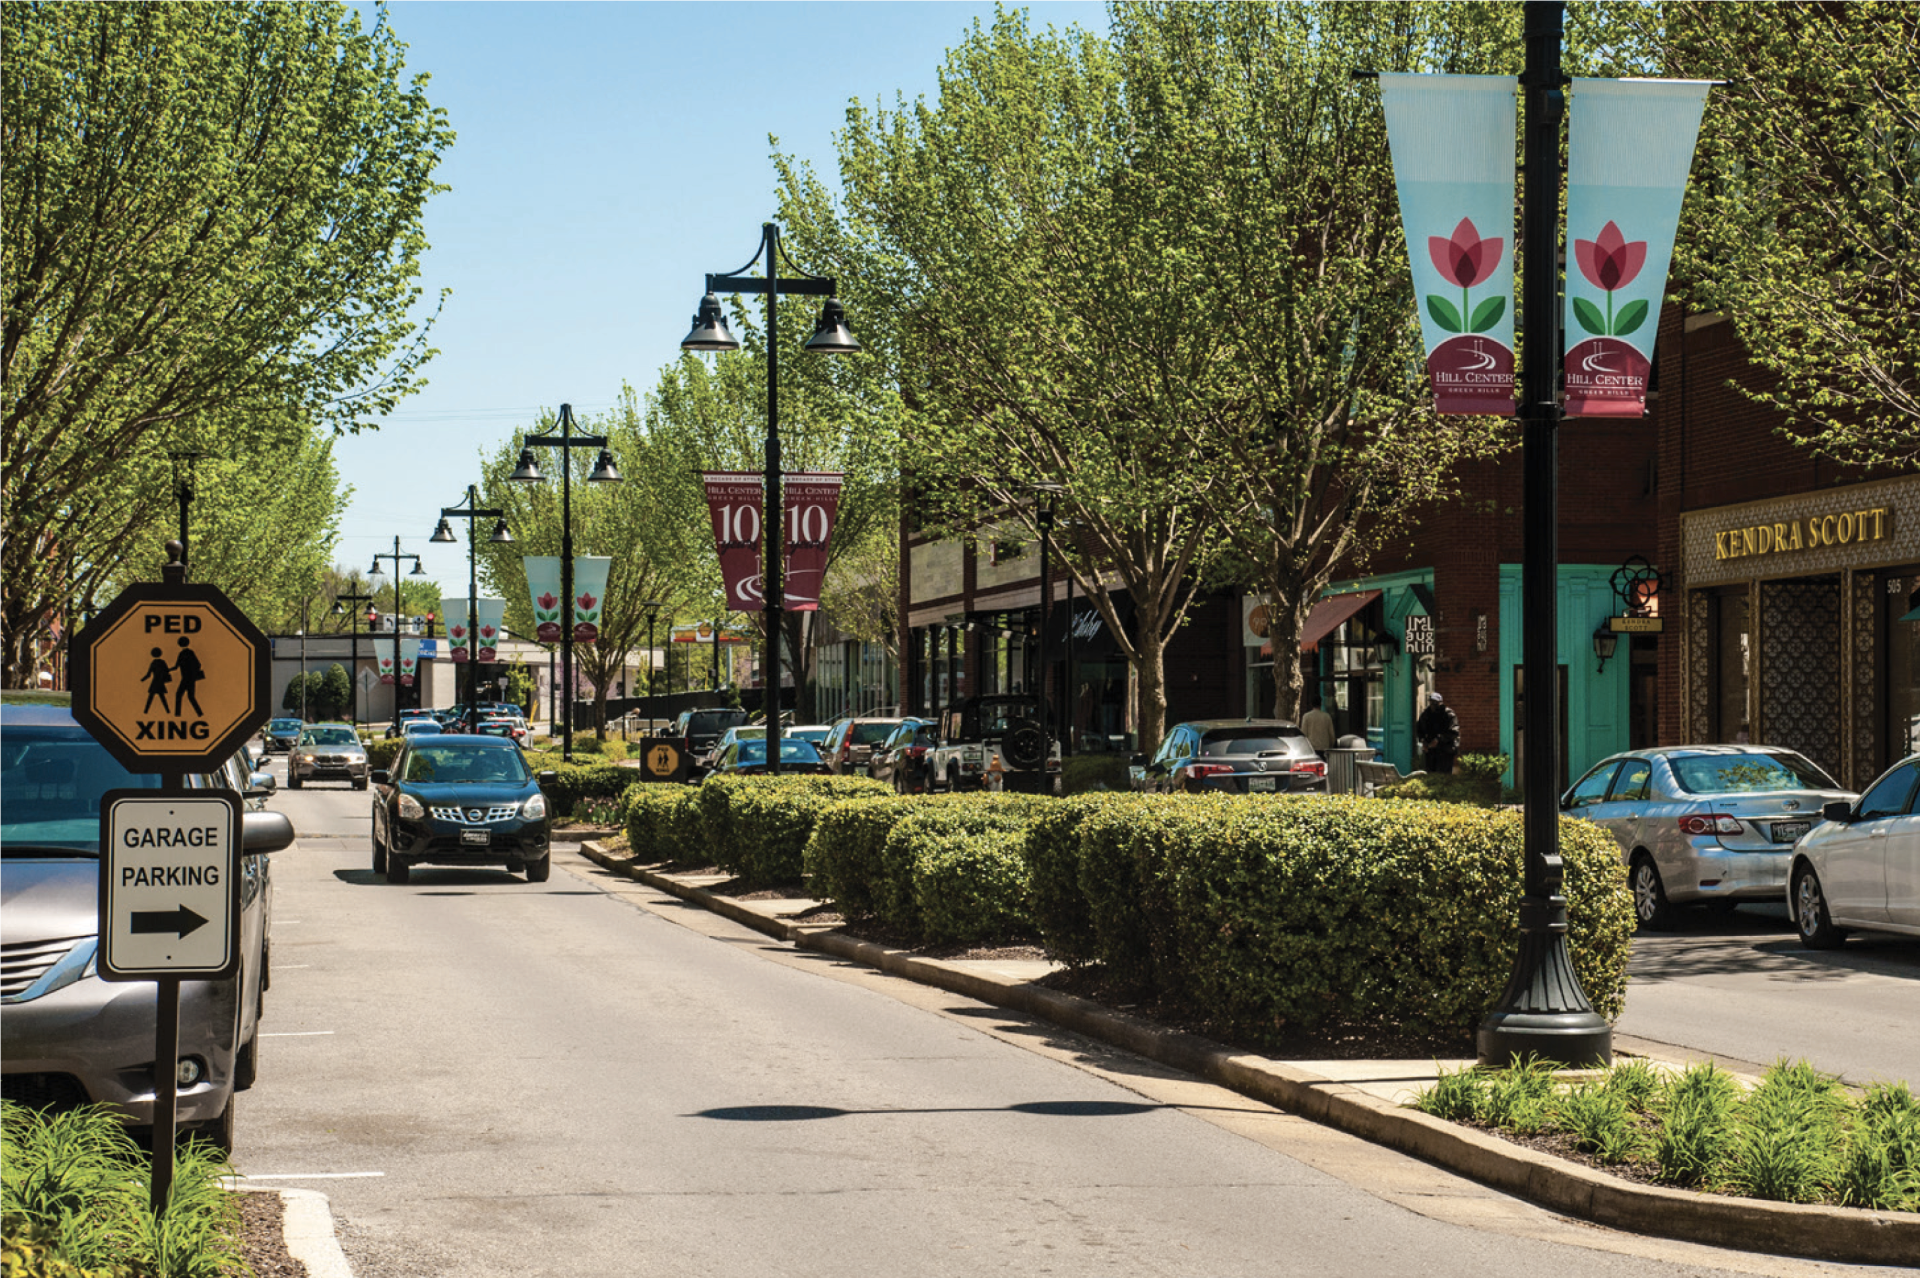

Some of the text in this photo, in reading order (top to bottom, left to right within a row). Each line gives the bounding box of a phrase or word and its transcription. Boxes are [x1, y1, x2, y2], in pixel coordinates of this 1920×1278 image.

[1465, 372, 1514, 384] CENTER
[1595, 374, 1643, 386] CENTER
[728, 486, 761, 495] CENTER
[804, 487, 839, 495] CENTER
[717, 504, 760, 545] 10
[786, 504, 829, 545] 10
[1716, 508, 1887, 560] KENDRA SCOTT
[144, 614, 202, 634] PED
[136, 720, 210, 741] XING
[123, 827, 218, 848] GARAGE
[122, 866, 220, 887] PARKING
